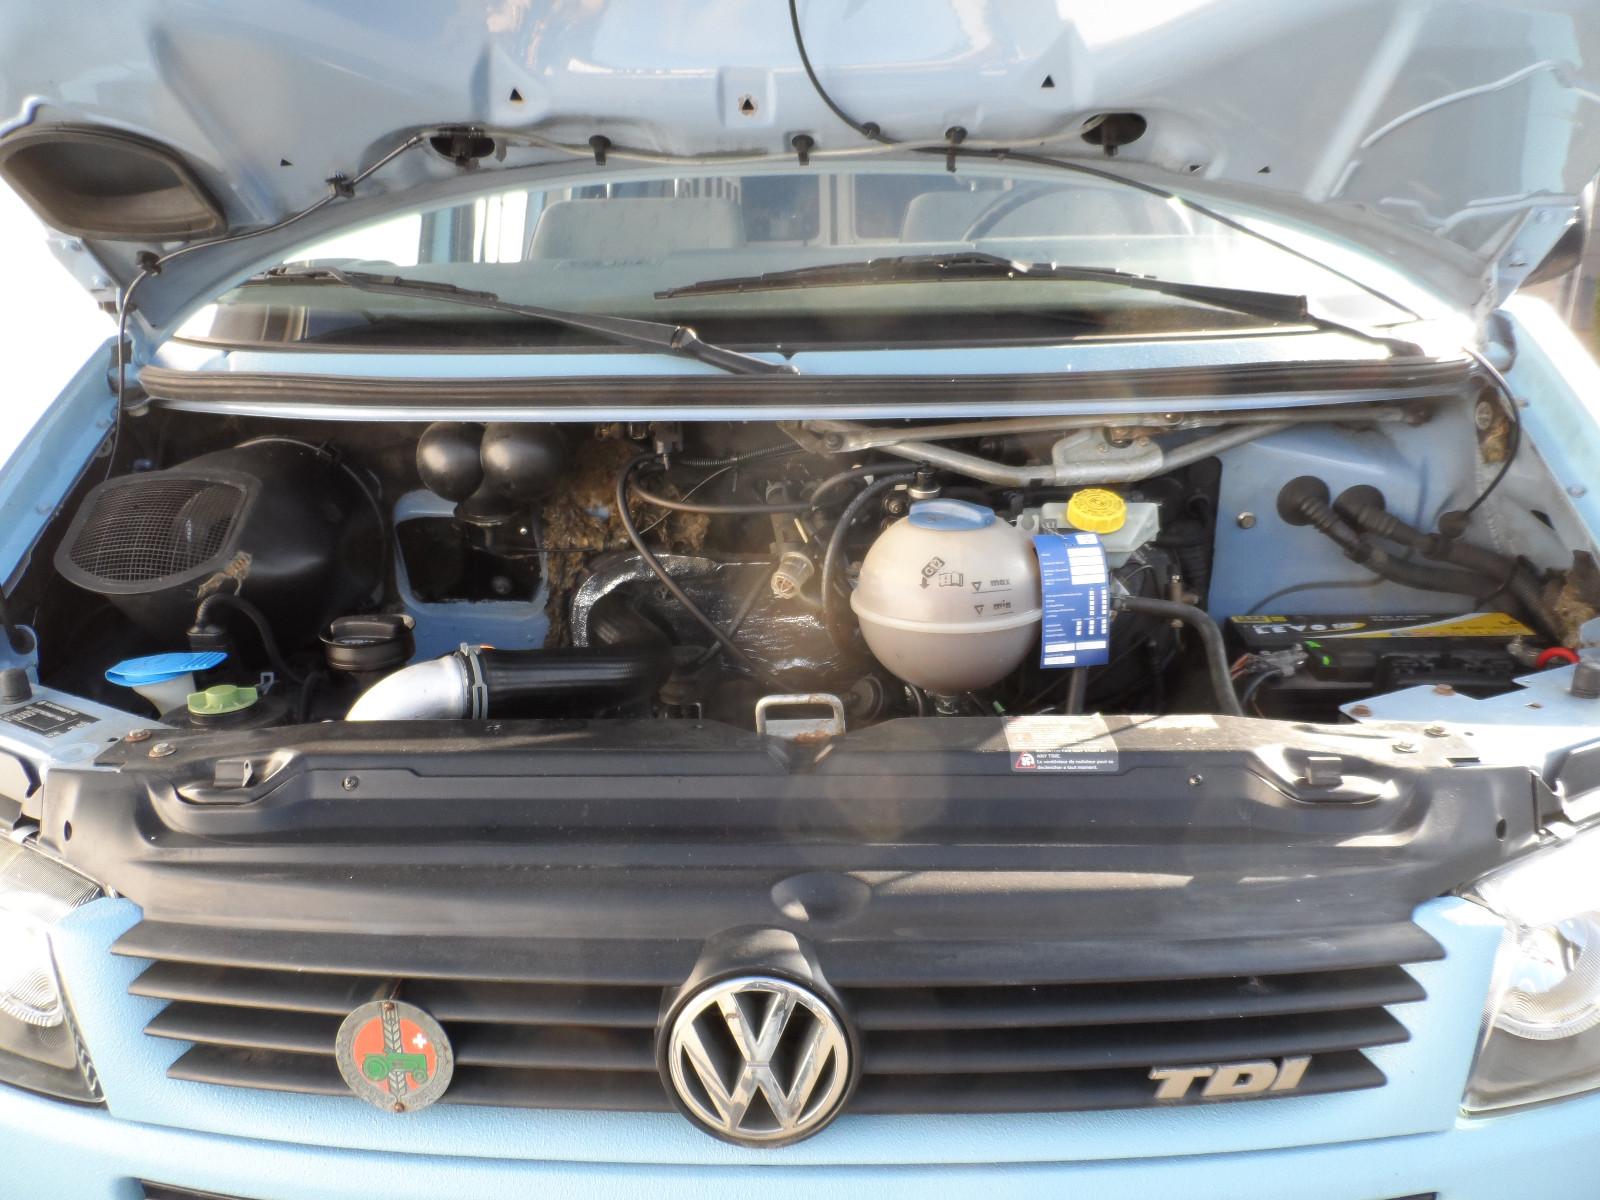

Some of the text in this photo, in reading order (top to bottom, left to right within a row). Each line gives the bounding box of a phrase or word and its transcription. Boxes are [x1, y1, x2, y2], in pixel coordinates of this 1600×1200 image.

[990, 579, 1010, 587] max
[993, 600, 1011, 610] min
[1148, 1055, 1312, 1099] TDI
